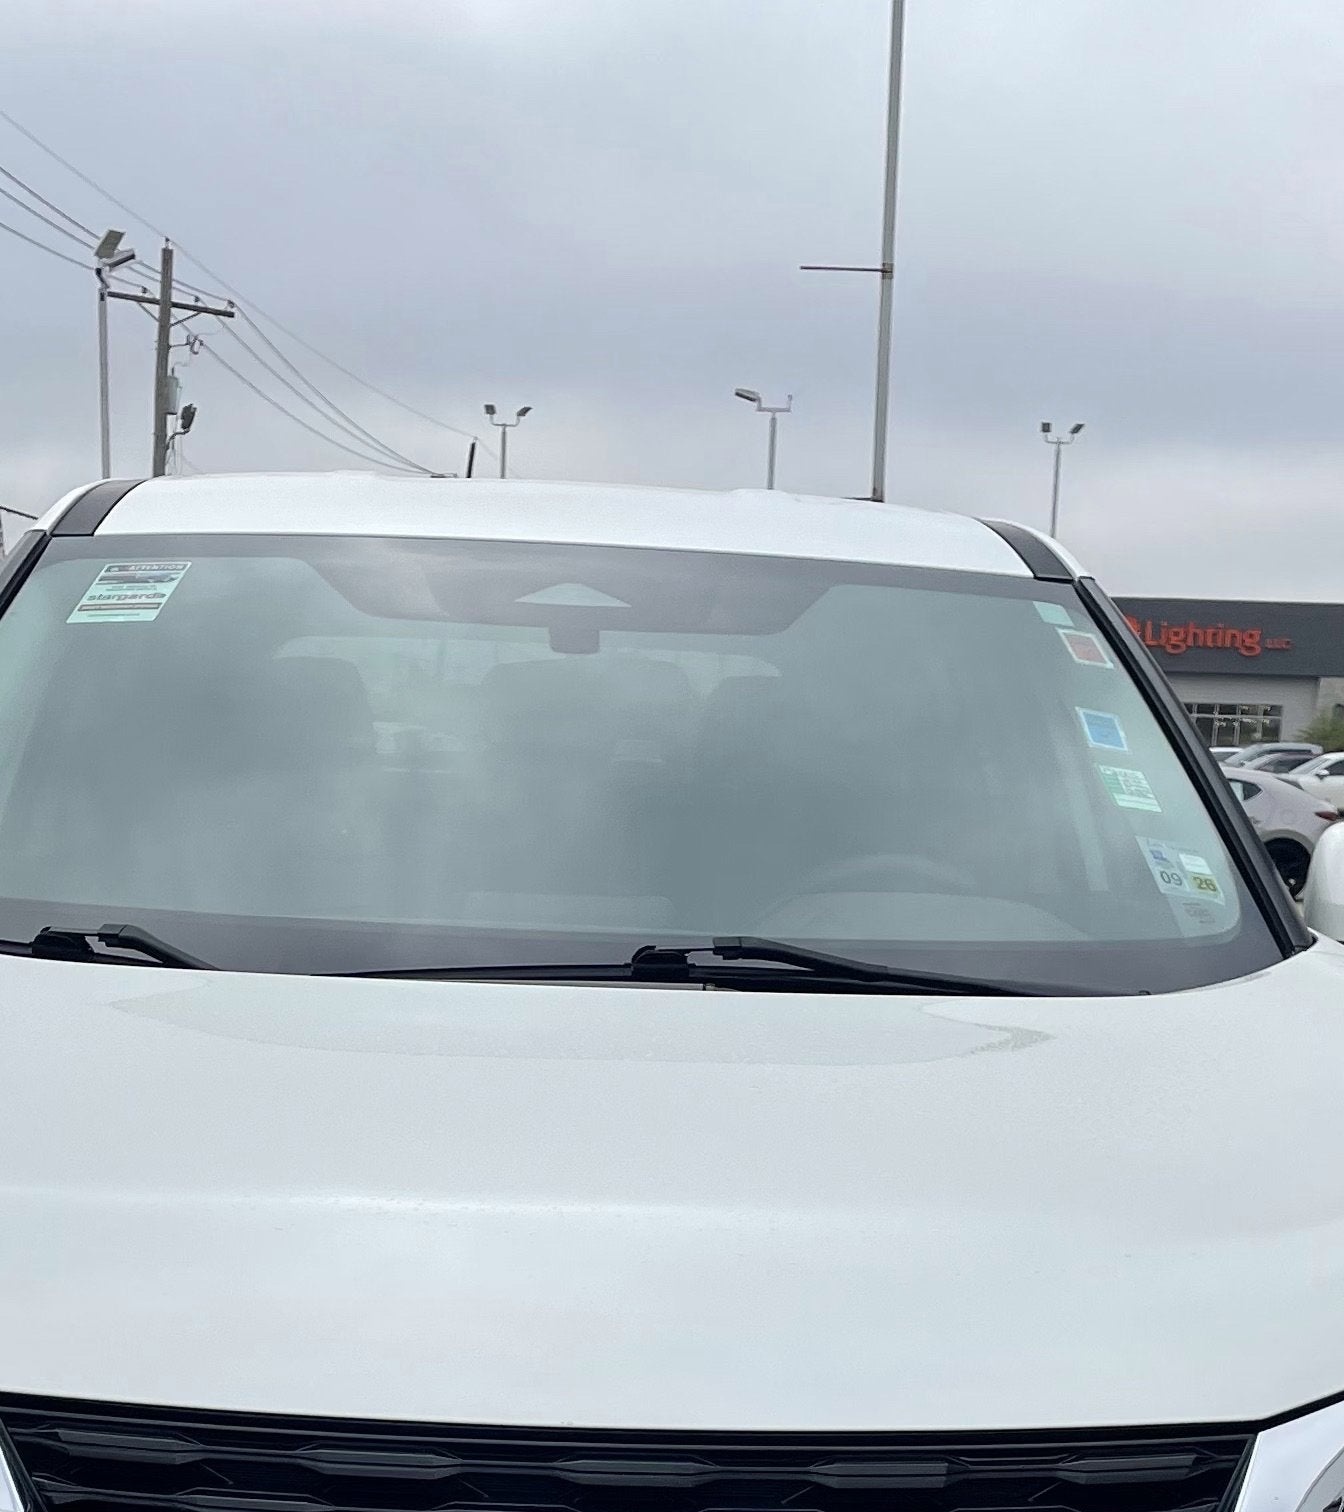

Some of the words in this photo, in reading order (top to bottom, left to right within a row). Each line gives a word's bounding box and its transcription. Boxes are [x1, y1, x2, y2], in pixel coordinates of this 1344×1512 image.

[1144, 619, 1262, 656] Lighting
[1159, 871, 1183, 886] 09
[1192, 875, 1217, 892] 26
